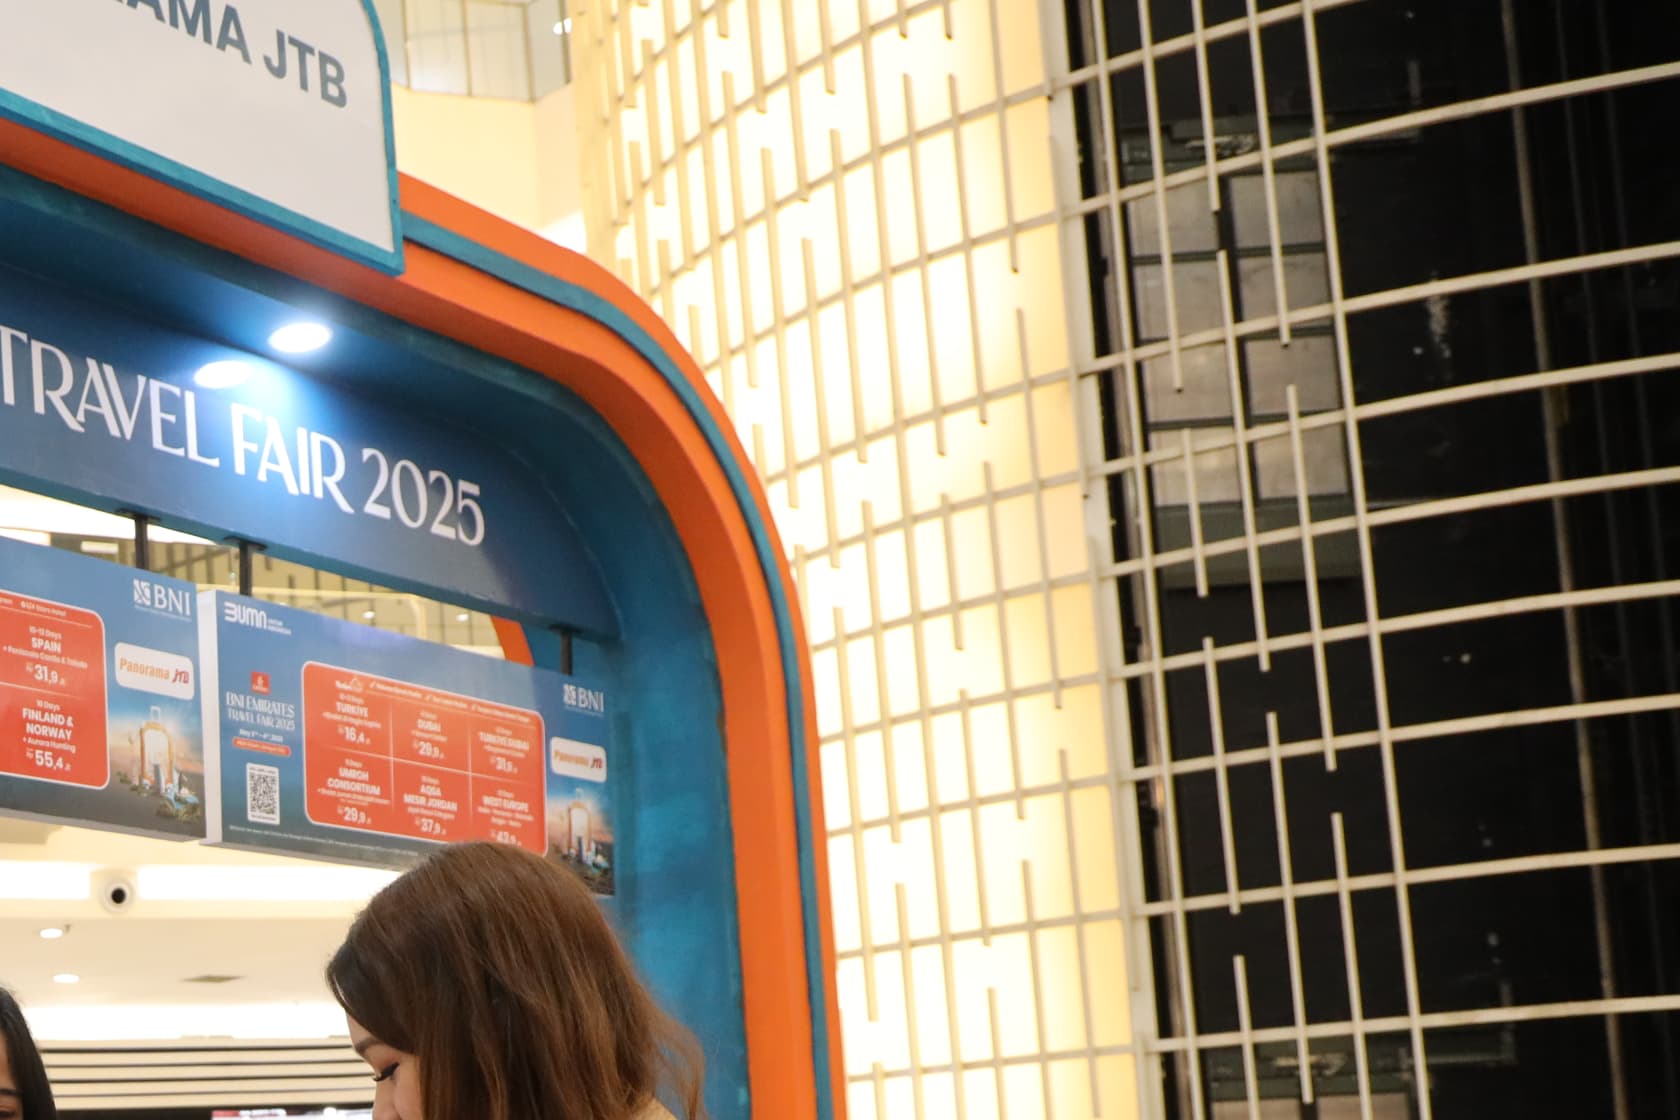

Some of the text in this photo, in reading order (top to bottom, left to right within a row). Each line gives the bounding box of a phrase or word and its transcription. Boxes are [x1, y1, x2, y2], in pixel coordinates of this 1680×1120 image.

[263, 29, 348, 109] JTB
[230, 401, 355, 514] FAIR
[361, 446, 486, 547] 2025
[154, 584, 191, 616] BNI
[31, 637, 61, 653] SPAIN
[120, 658, 169, 680] Panorama
[226, 691, 295, 718] BNI EMIRATES
[576, 686, 605, 714] BNI
[22, 707, 65, 725] FINLAND
[26, 722, 72, 740] NORWAY
[35, 750, 63, 770] 55,4
